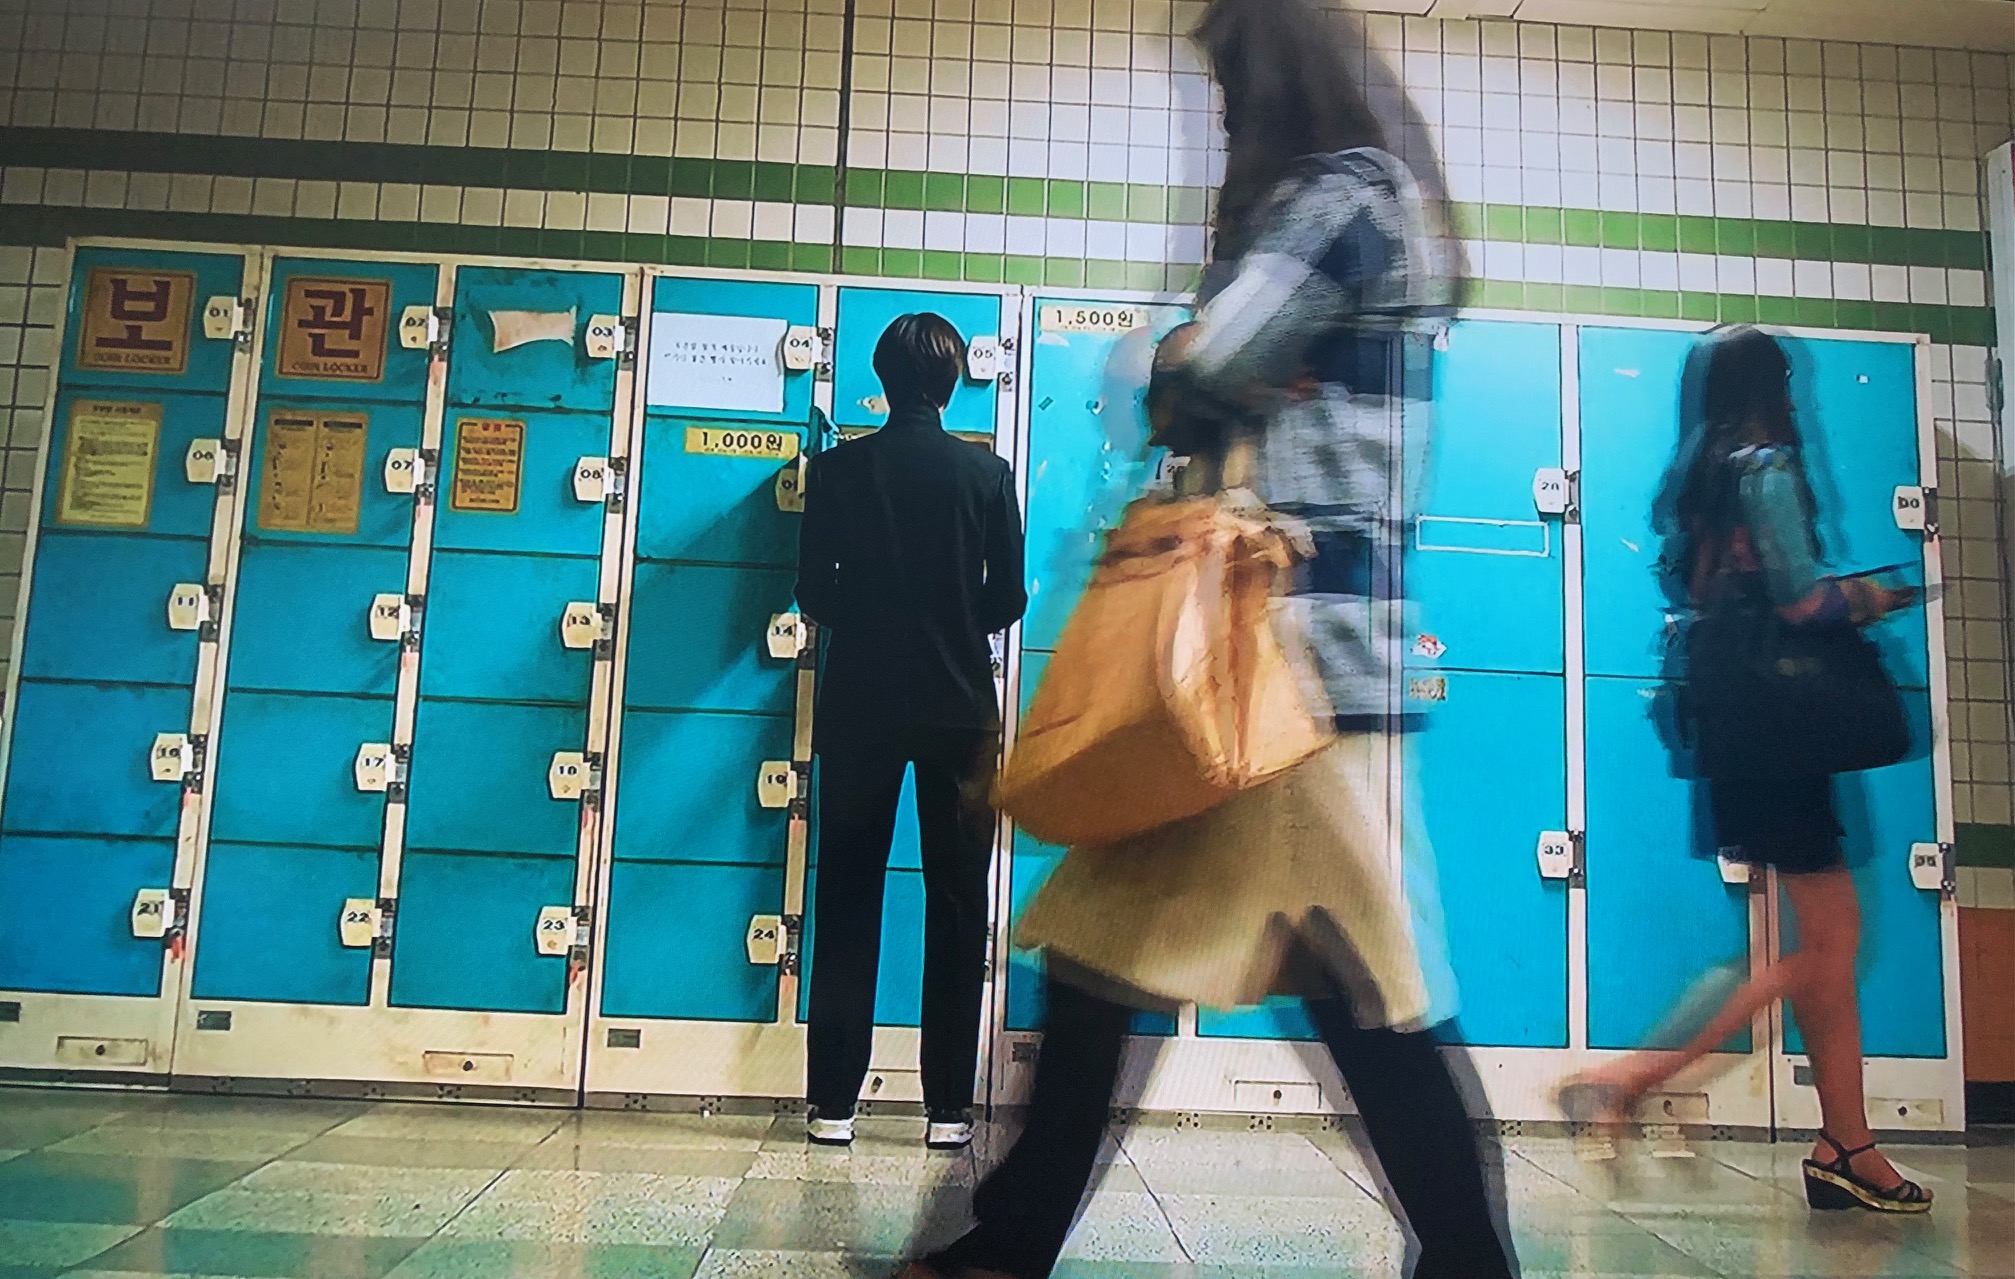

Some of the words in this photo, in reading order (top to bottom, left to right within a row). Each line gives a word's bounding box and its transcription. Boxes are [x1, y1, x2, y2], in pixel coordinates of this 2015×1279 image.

[95, 278, 173, 351] 보
[209, 307, 228, 317] 01
[1057, 309, 1133, 328] 1,500원
[297, 288, 374, 358] 관
[703, 431, 782, 451] 1,000원
[543, 920, 565, 930] 23
